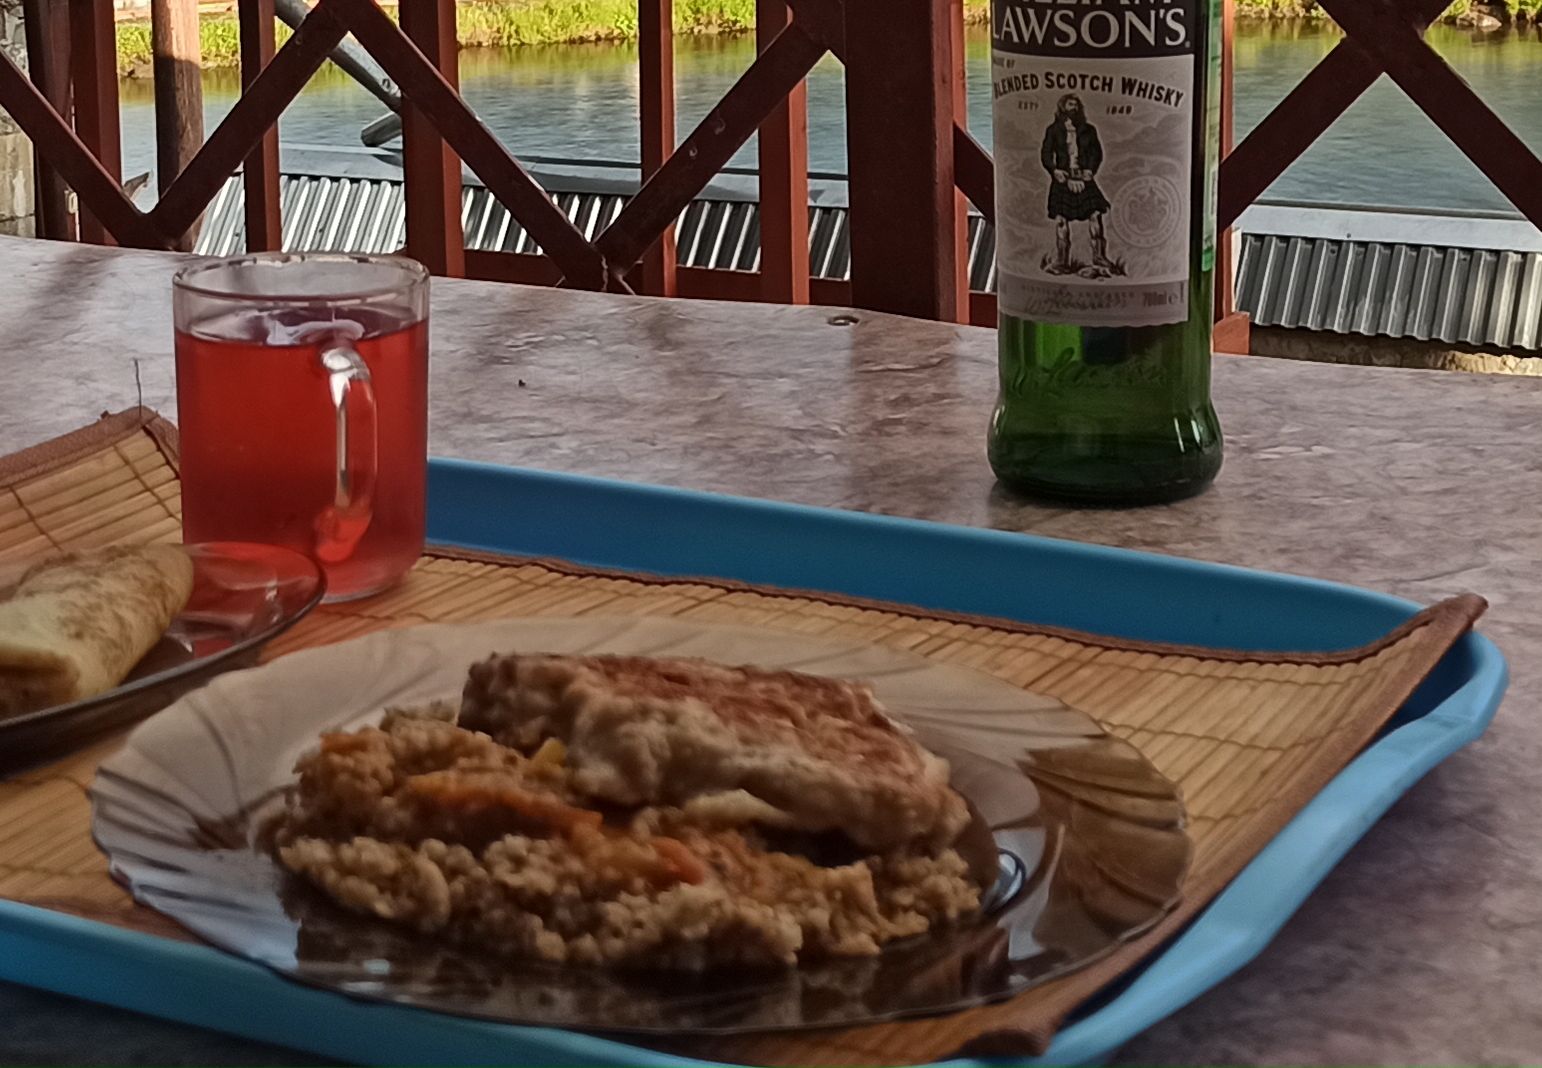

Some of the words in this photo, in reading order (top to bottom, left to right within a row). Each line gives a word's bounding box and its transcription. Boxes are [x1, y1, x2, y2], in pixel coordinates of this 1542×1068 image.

[992, 2, 1187, 48] LAWSON'S
[994, 73, 1039, 100] BLENDED
[1044, 71, 1114, 93] SCOTCH
[1121, 76, 1185, 108] WHISKY
